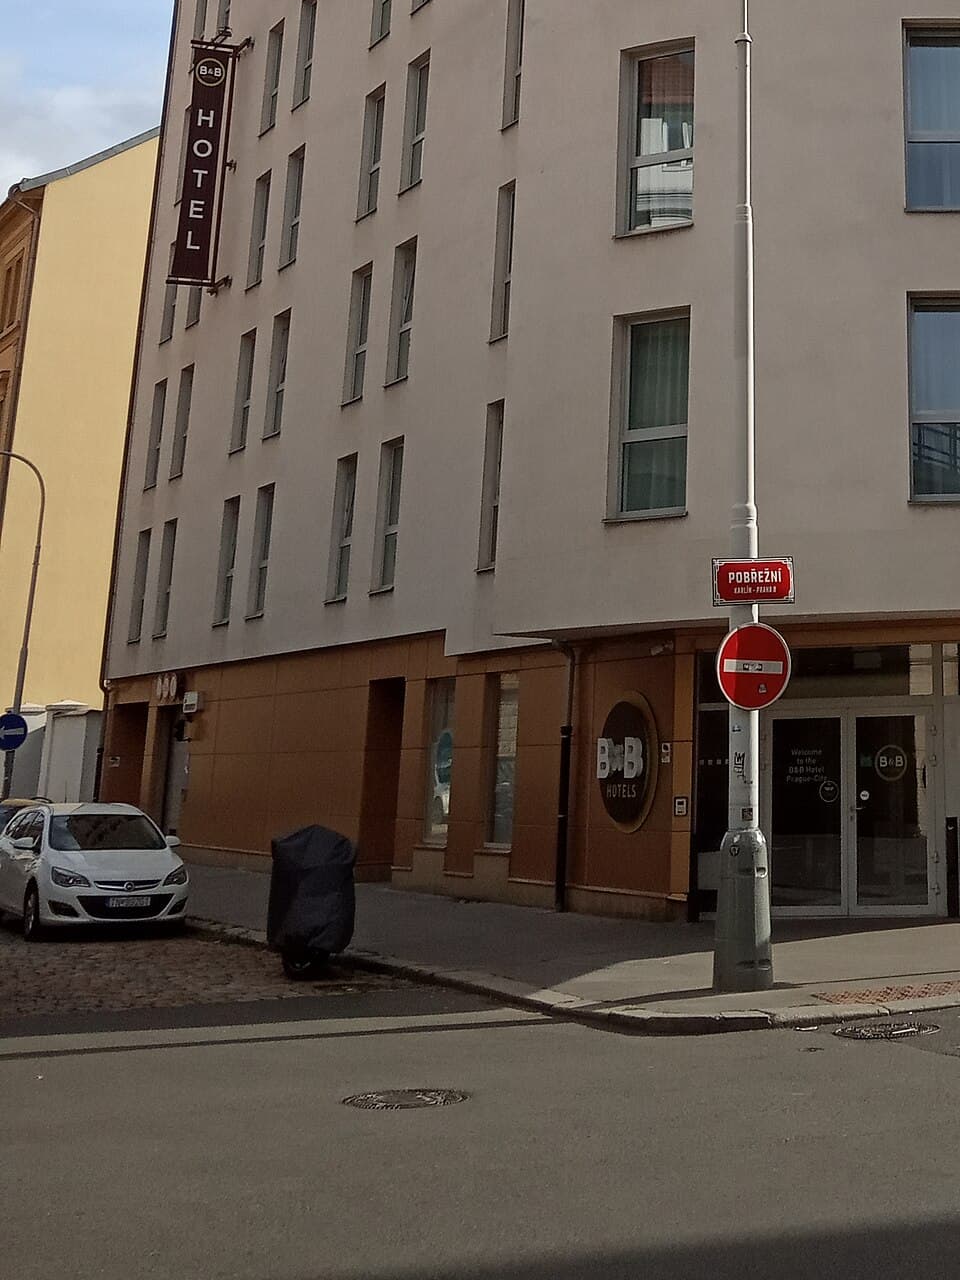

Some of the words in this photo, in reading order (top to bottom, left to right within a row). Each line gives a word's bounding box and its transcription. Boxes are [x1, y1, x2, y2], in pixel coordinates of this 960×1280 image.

[199, 65, 222, 77] B&B
[186, 109, 215, 250] HOTEL
[728, 567, 782, 583] POBŘEŽNÍ
[597, 736, 643, 779] B&B
[606, 784, 637, 798] HOTELS
